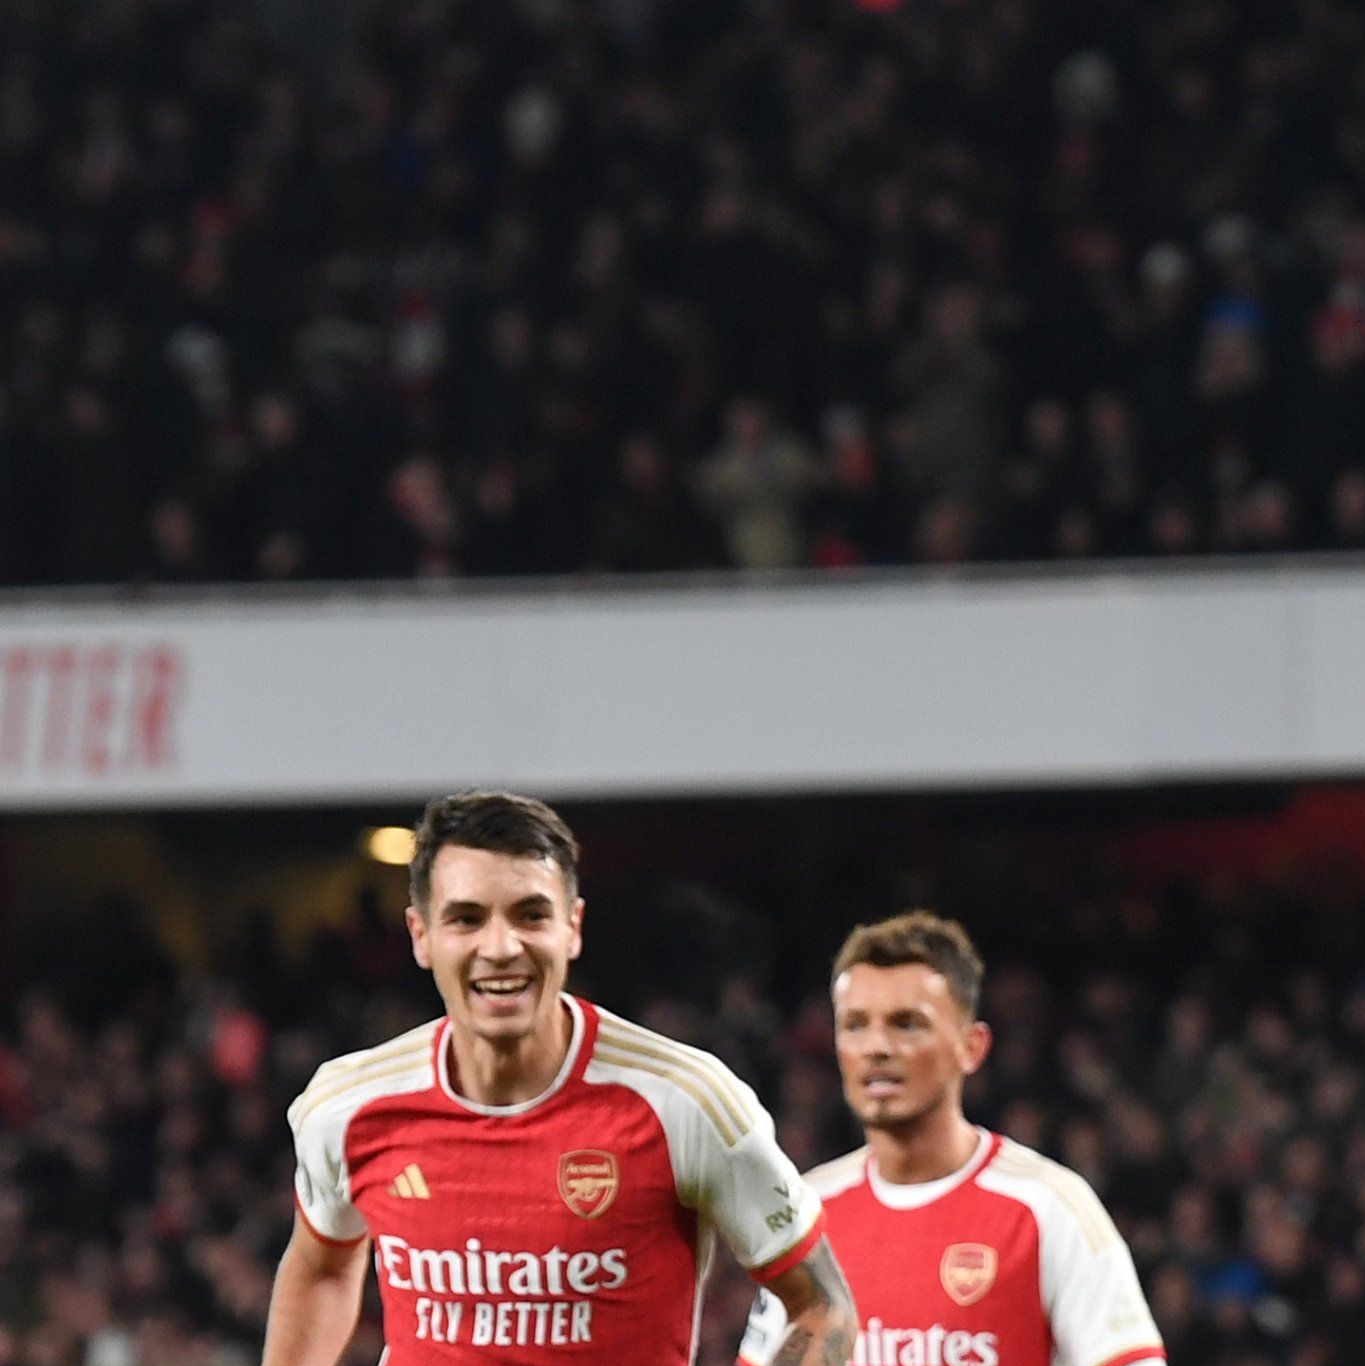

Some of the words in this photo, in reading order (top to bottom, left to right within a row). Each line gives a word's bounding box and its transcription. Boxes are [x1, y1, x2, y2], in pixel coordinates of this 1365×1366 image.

[379, 1234, 628, 1296] Emirates
[415, 1297, 463, 1344] FLY
[471, 1301, 593, 1346] BETTER
